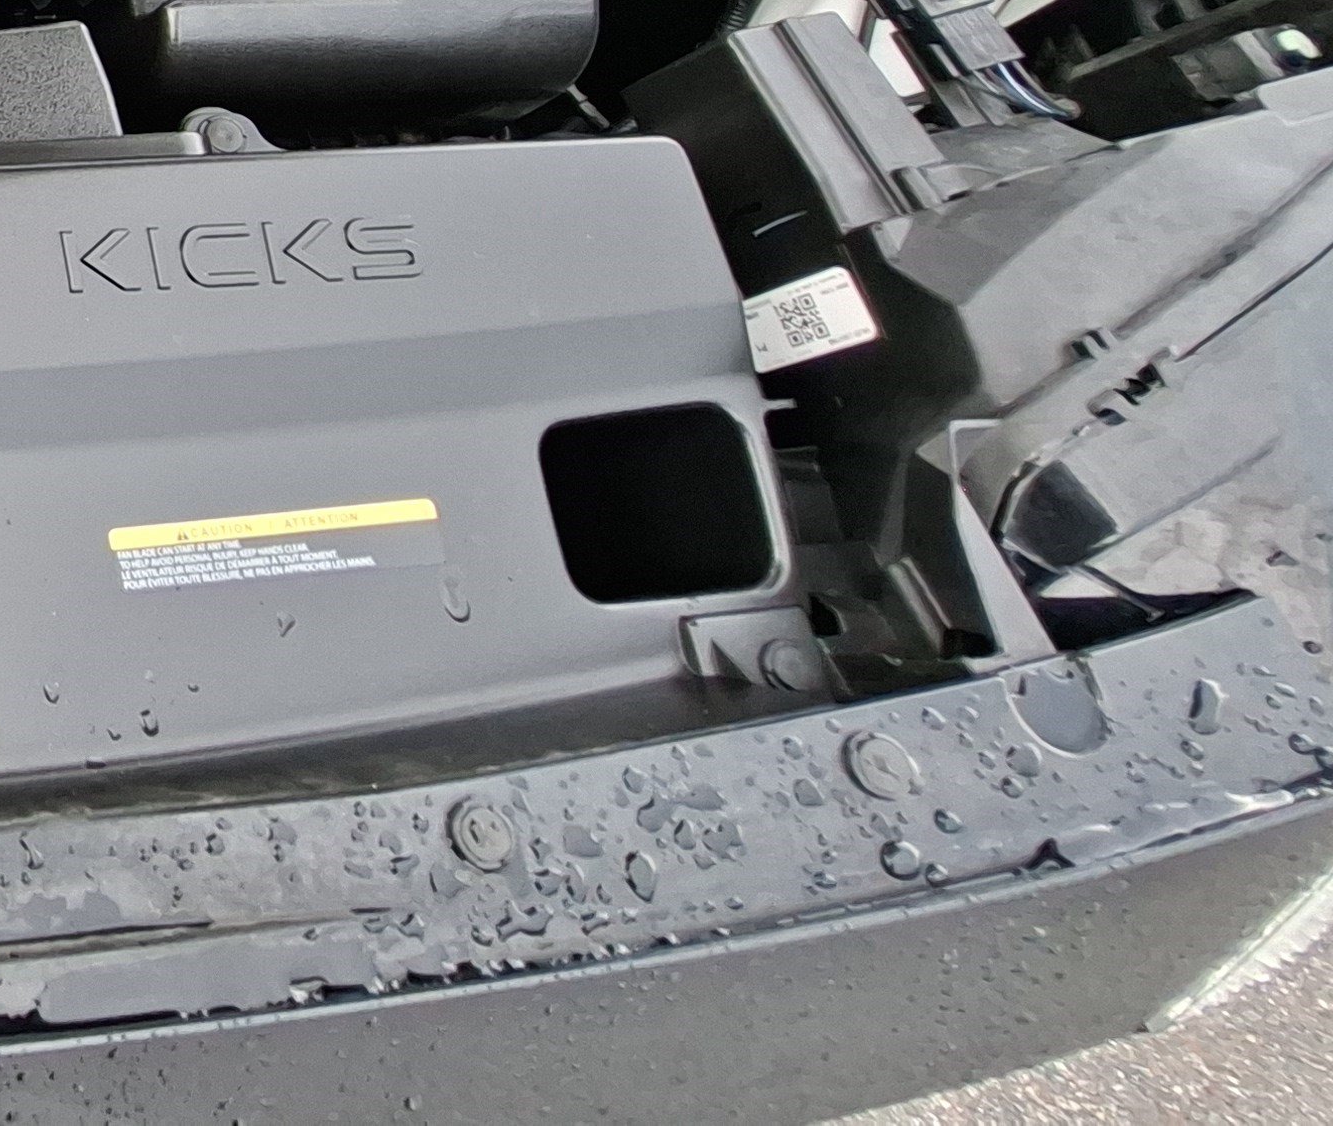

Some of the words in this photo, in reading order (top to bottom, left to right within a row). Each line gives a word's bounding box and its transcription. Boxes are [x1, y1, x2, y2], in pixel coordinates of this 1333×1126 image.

[58, 216, 424, 295] KICKS
[190, 523, 254, 539] CAUTION
[284, 513, 359, 529] ATTENTION
[119, 559, 131, 570] TO
[131, 557, 150, 569] HELP
[151, 555, 174, 567] AVOID
[174, 552, 212, 565] PERSONAL
[239, 547, 257, 559] KEEP
[257, 544, 283, 556] HANDS
[132, 546, 156, 558] BLADE
[157, 545, 174, 556] CAN
[174, 543, 196, 555] START
[196, 542, 207, 553] AT
[207, 541, 223, 552] ANY
[120, 570, 131, 581] LE
[131, 565, 184, 579] VENTILATEUR
[184, 562, 214, 575] RISQUE
[214, 560, 226, 572] DE
[278, 552, 300, 564] TOUT
[123, 578, 148, 591] POUR
[175, 573, 201, 585] TOUTE
[242, 568, 256, 580] NE
[255, 567, 271, 578] PAS
[270, 565, 283, 576] EN
[283, 560, 333, 574] APPROCHER
[332, 558, 347, 570] LES
